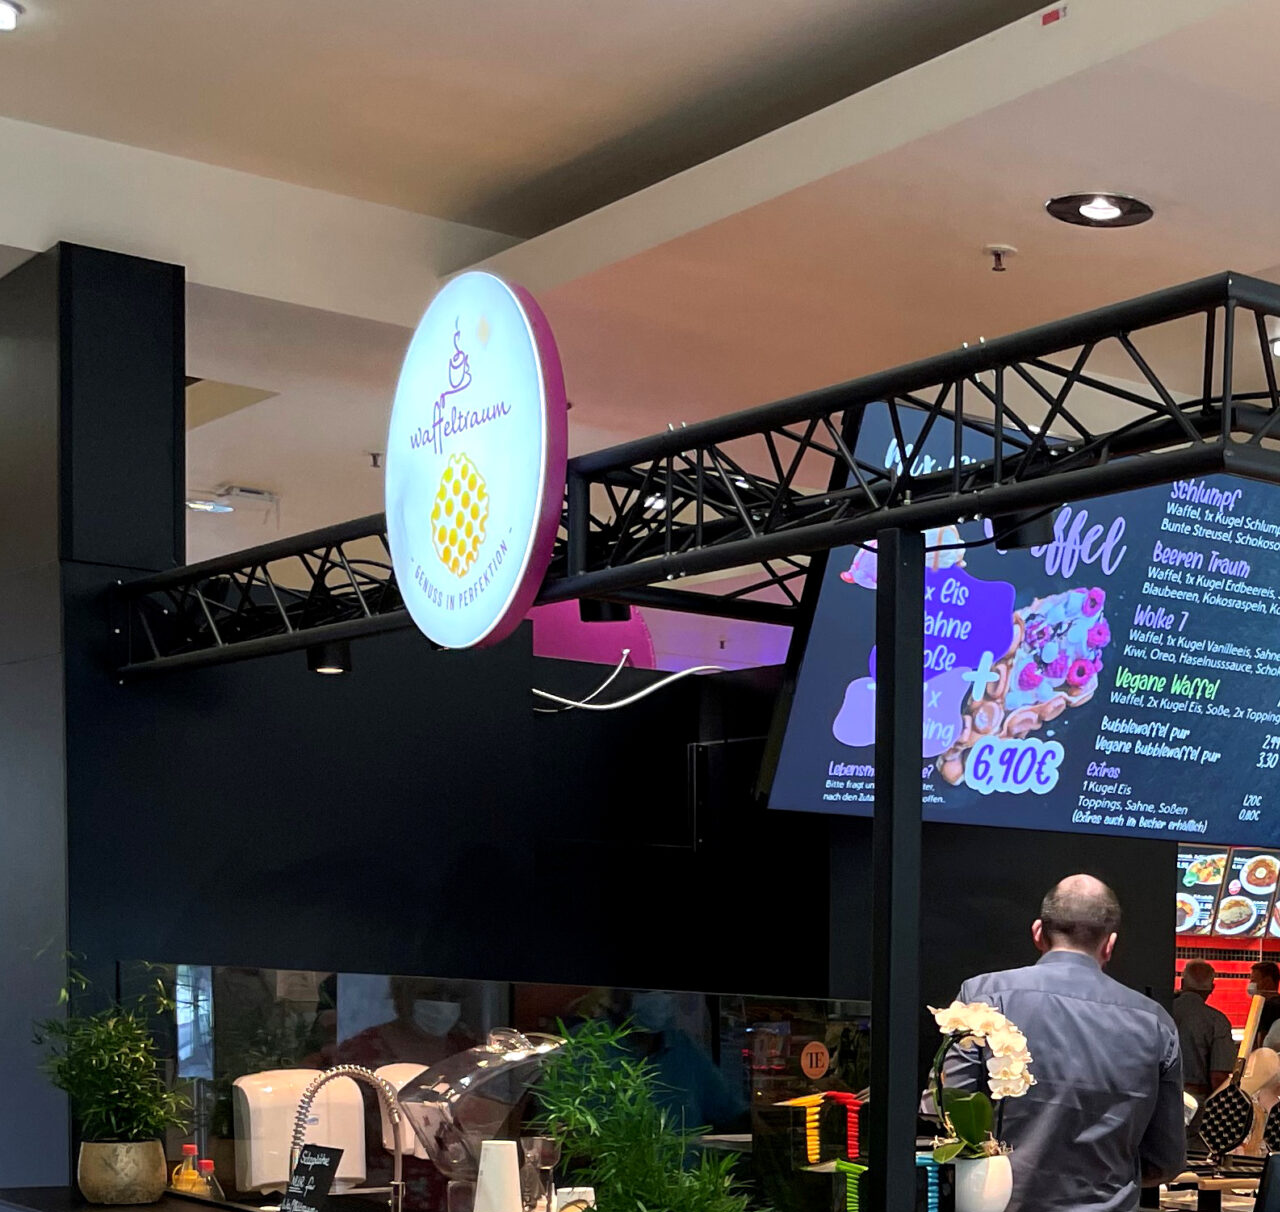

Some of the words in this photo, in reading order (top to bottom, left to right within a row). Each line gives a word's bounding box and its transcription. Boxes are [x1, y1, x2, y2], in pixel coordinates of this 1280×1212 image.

[410, 394, 512, 455] waffeltraum
[1166, 502, 1201, 522] Waffel,
[1204, 509, 1214, 522] 1x
[1215, 512, 1244, 530] Kugel
[1161, 518, 1192, 535] Bunte
[1192, 523, 1233, 545] Streusel,
[1152, 540, 1203, 570] Beeren
[1207, 550, 1250, 578] Traum
[414, 563, 444, 608] GENUSS
[446, 593, 455, 610] IN
[458, 540, 509, 610] PERFEKTION
[1148, 566, 1182, 585] Waffel,
[1185, 573, 1195, 585] 1x
[1196, 575, 1224, 593] Kugel
[1225, 579, 1276, 600] Erdbeereis,
[1142, 581, 1200, 604] Blaubeeren,
[1202, 592, 1267, 615] Kokosraspeln,
[924, 611, 972, 639] ahne
[1133, 604, 1175, 632] Wolke
[1178, 612, 1190, 632] 7
[1129, 628, 1164, 647] Waffel,
[1166, 635, 1176, 648] 1x
[1177, 637, 1206, 655] Kugel
[1207, 642, 1251, 659] Vanilleeis,
[1123, 644, 1148, 660] Kiwi,
[1150, 648, 1177, 664] Oreo,
[1179, 652, 1253, 674] Haselnusssauce,
[1115, 665, 1166, 694] Vegane
[1170, 673, 1221, 700] Waffel
[1110, 691, 1145, 708] Waffel,
[1147, 696, 1159, 709] 2x
[1160, 698, 1189, 714] Kugel
[1189, 702, 1204, 716] Eis,
[1206, 705, 1231, 719] Soße,
[1233, 706, 1245, 719] 2x
[1101, 715, 1169, 739] Bubblewaffel
[1170, 726, 1191, 741] pur
[1095, 736, 1132, 755] Vegane
[1202, 750, 1221, 765] pur
[972, 747, 1056, 785] 6,90€
[1088, 781, 1117, 794] Kugel
[1117, 784, 1132, 795] Eis
[1078, 795, 1123, 811] Toppings,
[1125, 801, 1156, 814] Sahne,
